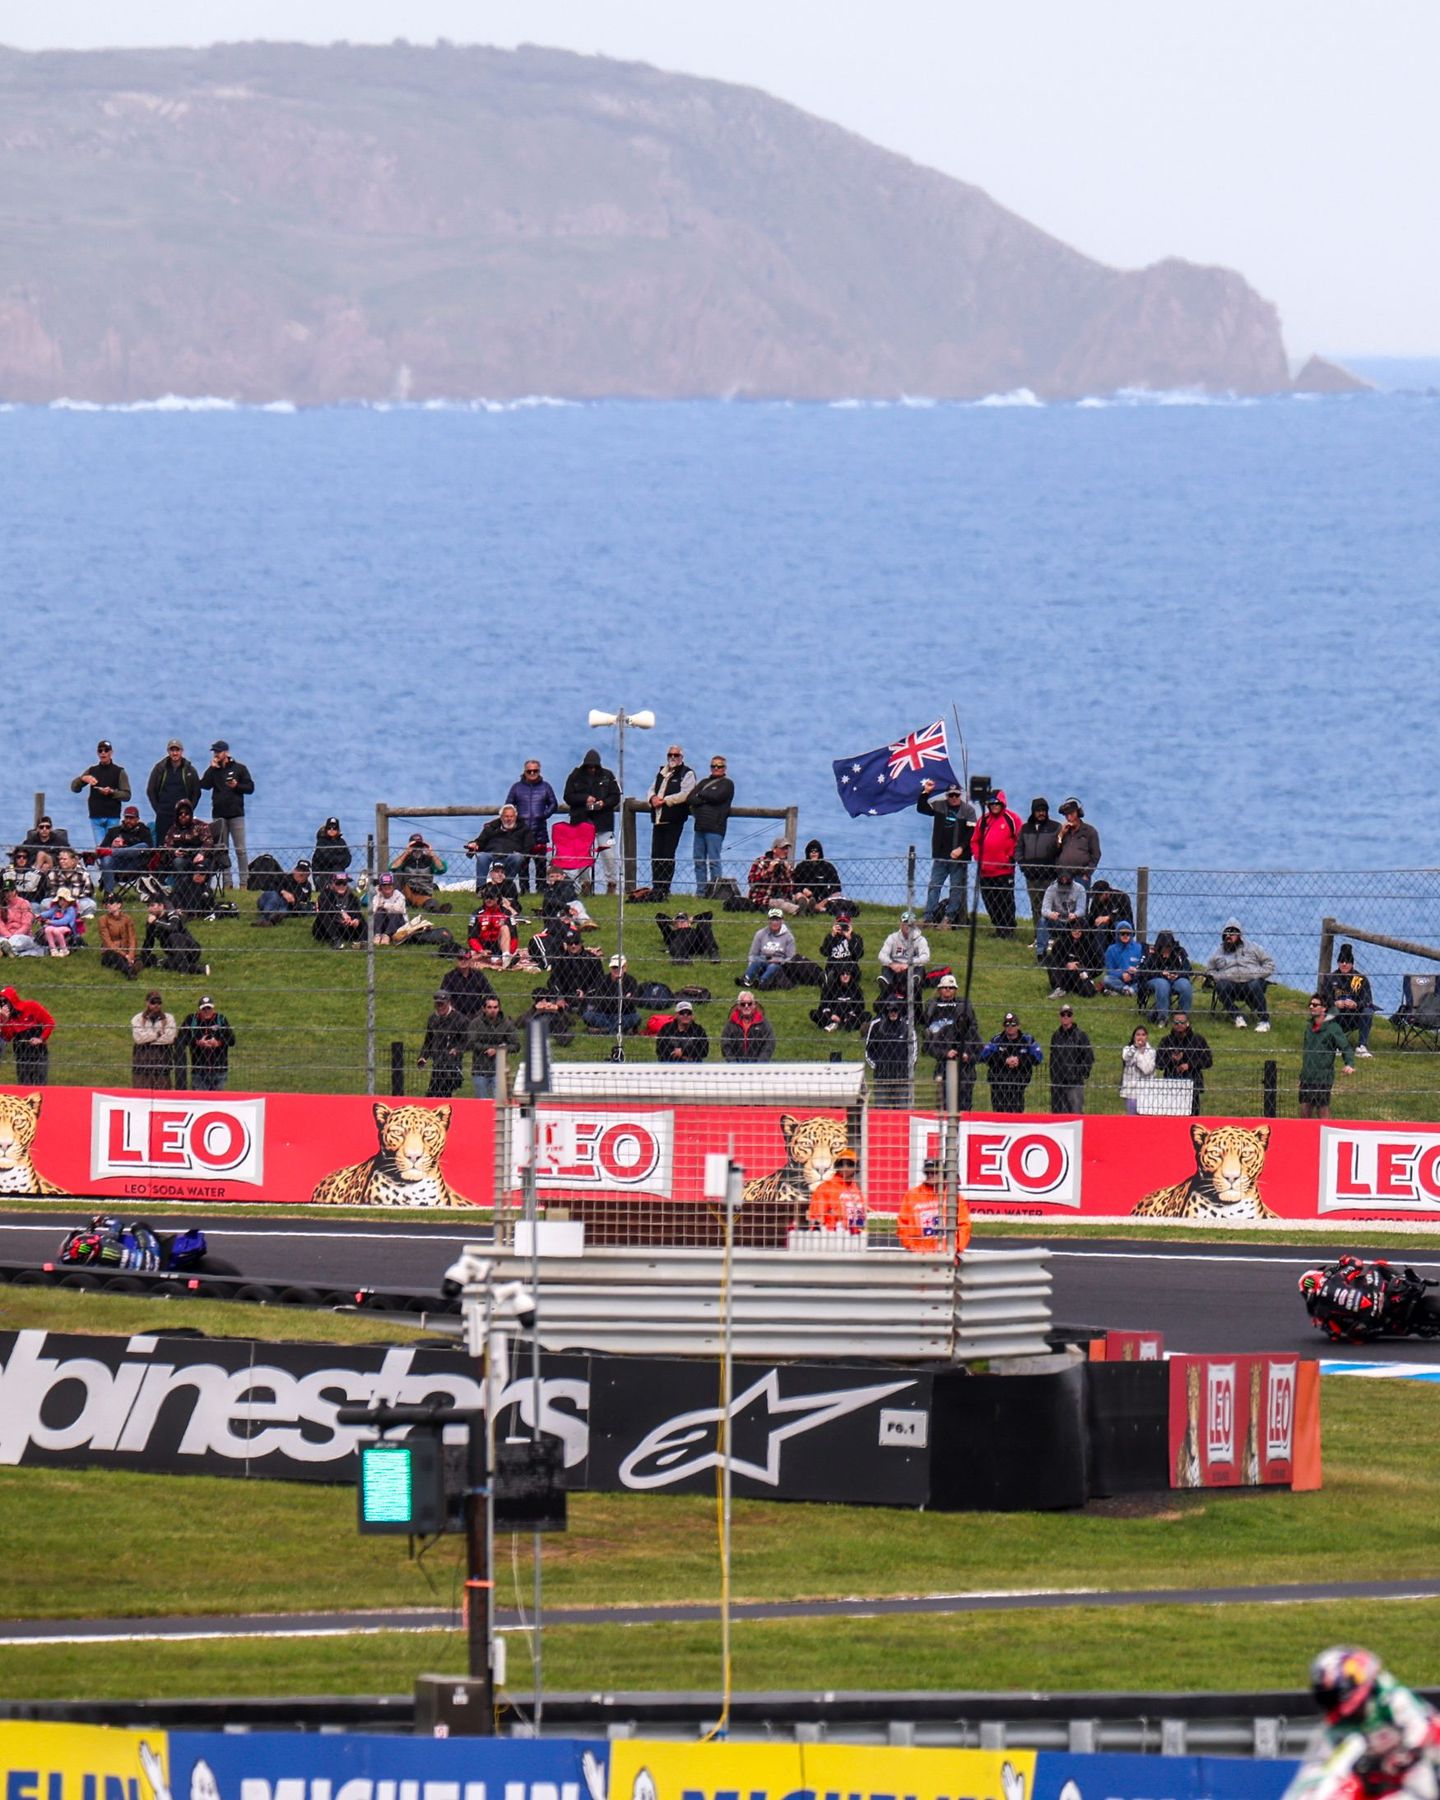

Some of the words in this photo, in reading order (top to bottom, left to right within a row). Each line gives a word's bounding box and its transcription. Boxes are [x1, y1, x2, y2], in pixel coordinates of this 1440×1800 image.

[109, 1109, 247, 1167] LEO
[124, 1184, 147, 1194] LEO
[152, 1185, 185, 1196] SODA
[187, 1186, 226, 1197] WATER
[1210, 1379, 1232, 1445] LEO
[1269, 1377, 1291, 1442] LEO
